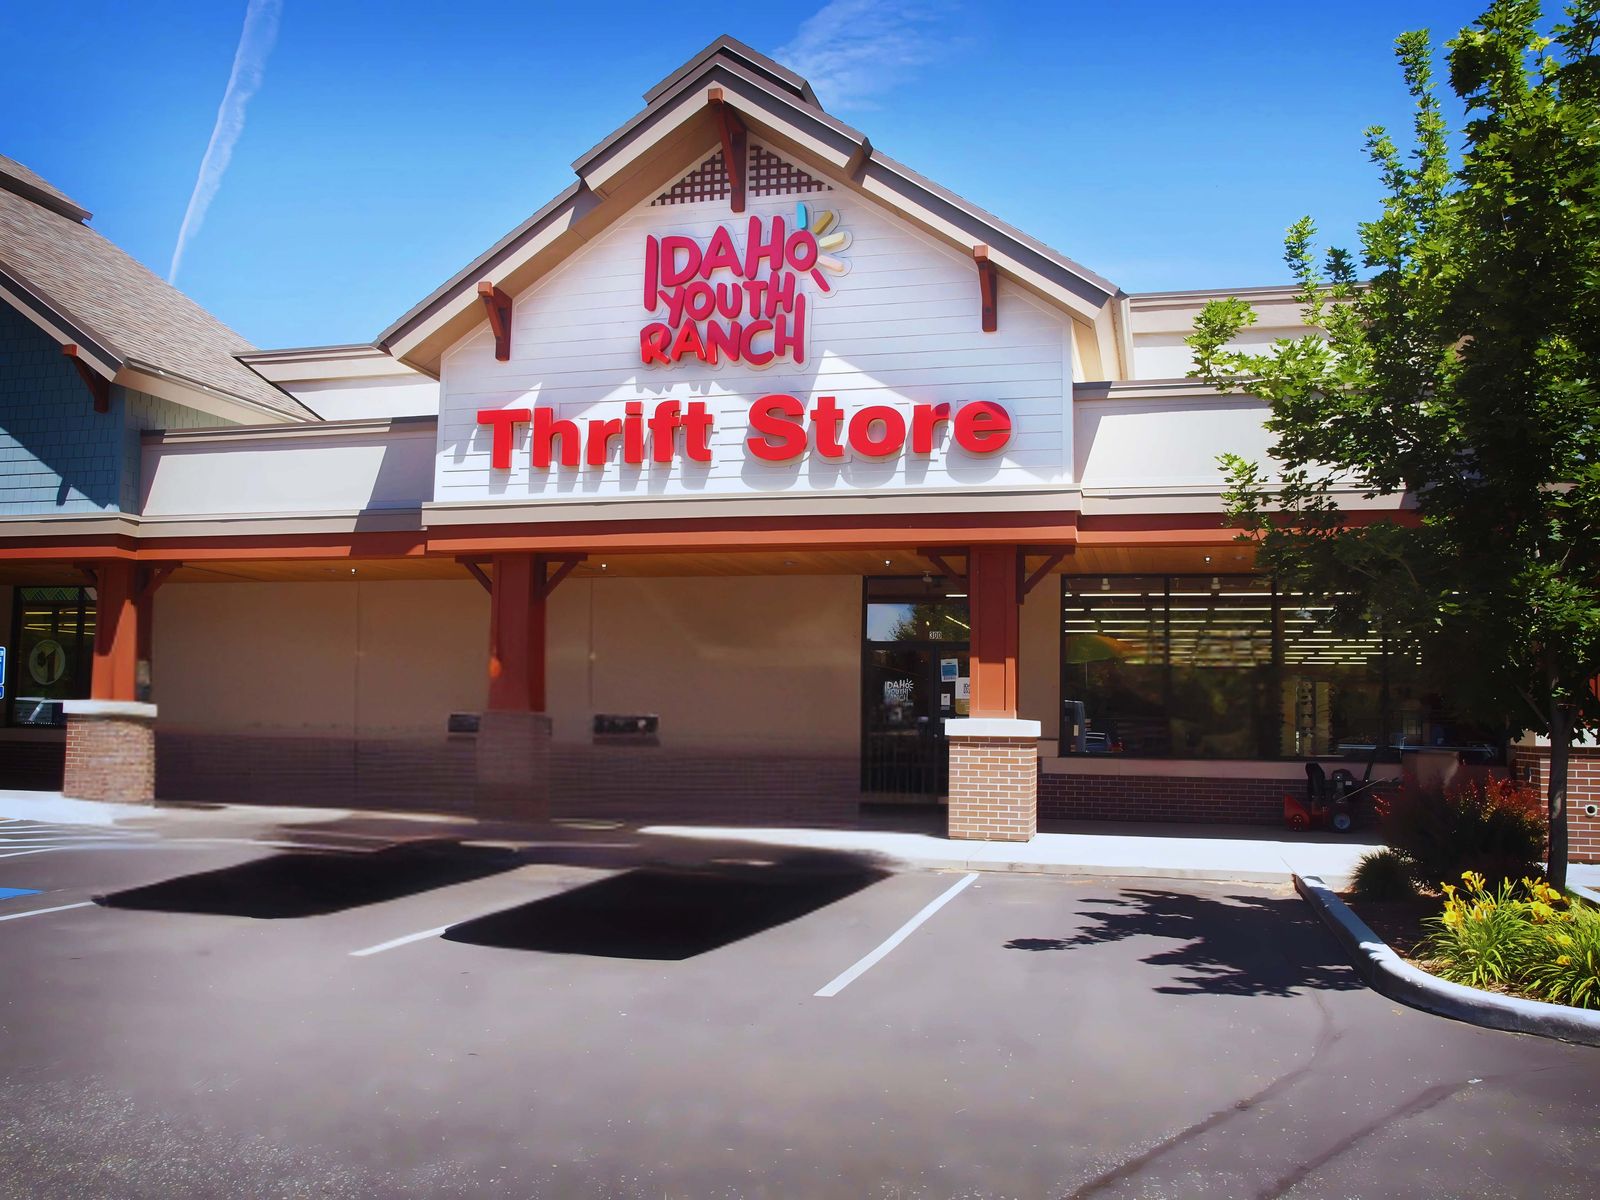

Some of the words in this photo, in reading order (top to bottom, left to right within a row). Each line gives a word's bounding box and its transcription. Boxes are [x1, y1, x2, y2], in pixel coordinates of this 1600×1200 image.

[643, 215, 818, 312] IDAHO
[657, 270, 796, 329] YOUTH
[639, 292, 806, 366] RANCH
[476, 399, 713, 470] Thrift
[747, 393, 1012, 461] Store
[884, 679, 910, 694] IDAHO
